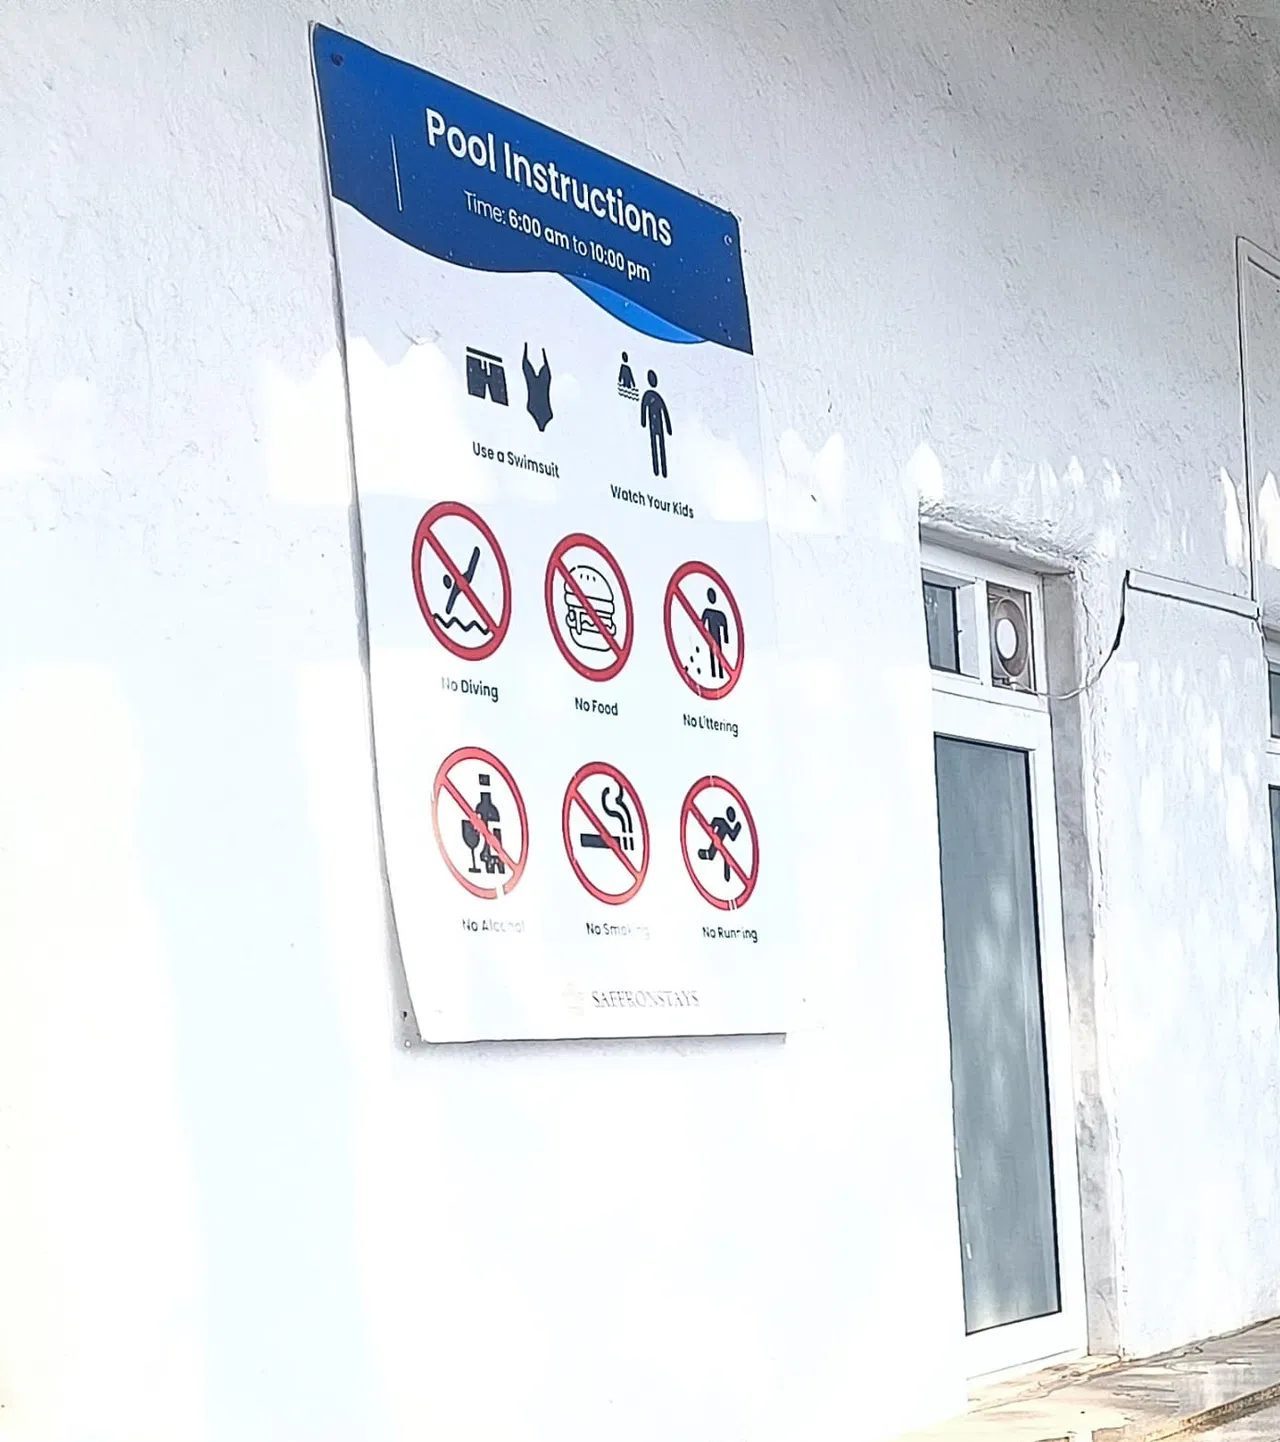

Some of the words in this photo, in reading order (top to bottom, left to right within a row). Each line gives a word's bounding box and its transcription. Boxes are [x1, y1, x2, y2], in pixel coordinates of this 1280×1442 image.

[425, 108, 497, 173] Pool
[505, 142, 673, 247] Instructions
[464, 190, 507, 225] Time:
[508, 212, 541, 238] 6:00
[544, 227, 570, 250] am
[572, 234, 587, 256] to
[590, 240, 625, 273] 10:00
[627, 259, 651, 283] pm
[472, 441, 494, 458] Use
[496, 449, 504, 463] a
[507, 452, 560, 479] Swimsuit
[610, 484, 645, 506] Watch
[647, 494, 672, 513] Your
[672, 501, 694, 519] Kids
[461, 679, 499, 704] Diving
[575, 697, 590, 713] No
[592, 699, 619, 716] Food
[683, 713, 697, 728] No
[586, 922, 601, 936] No
[702, 926, 717, 940] No
